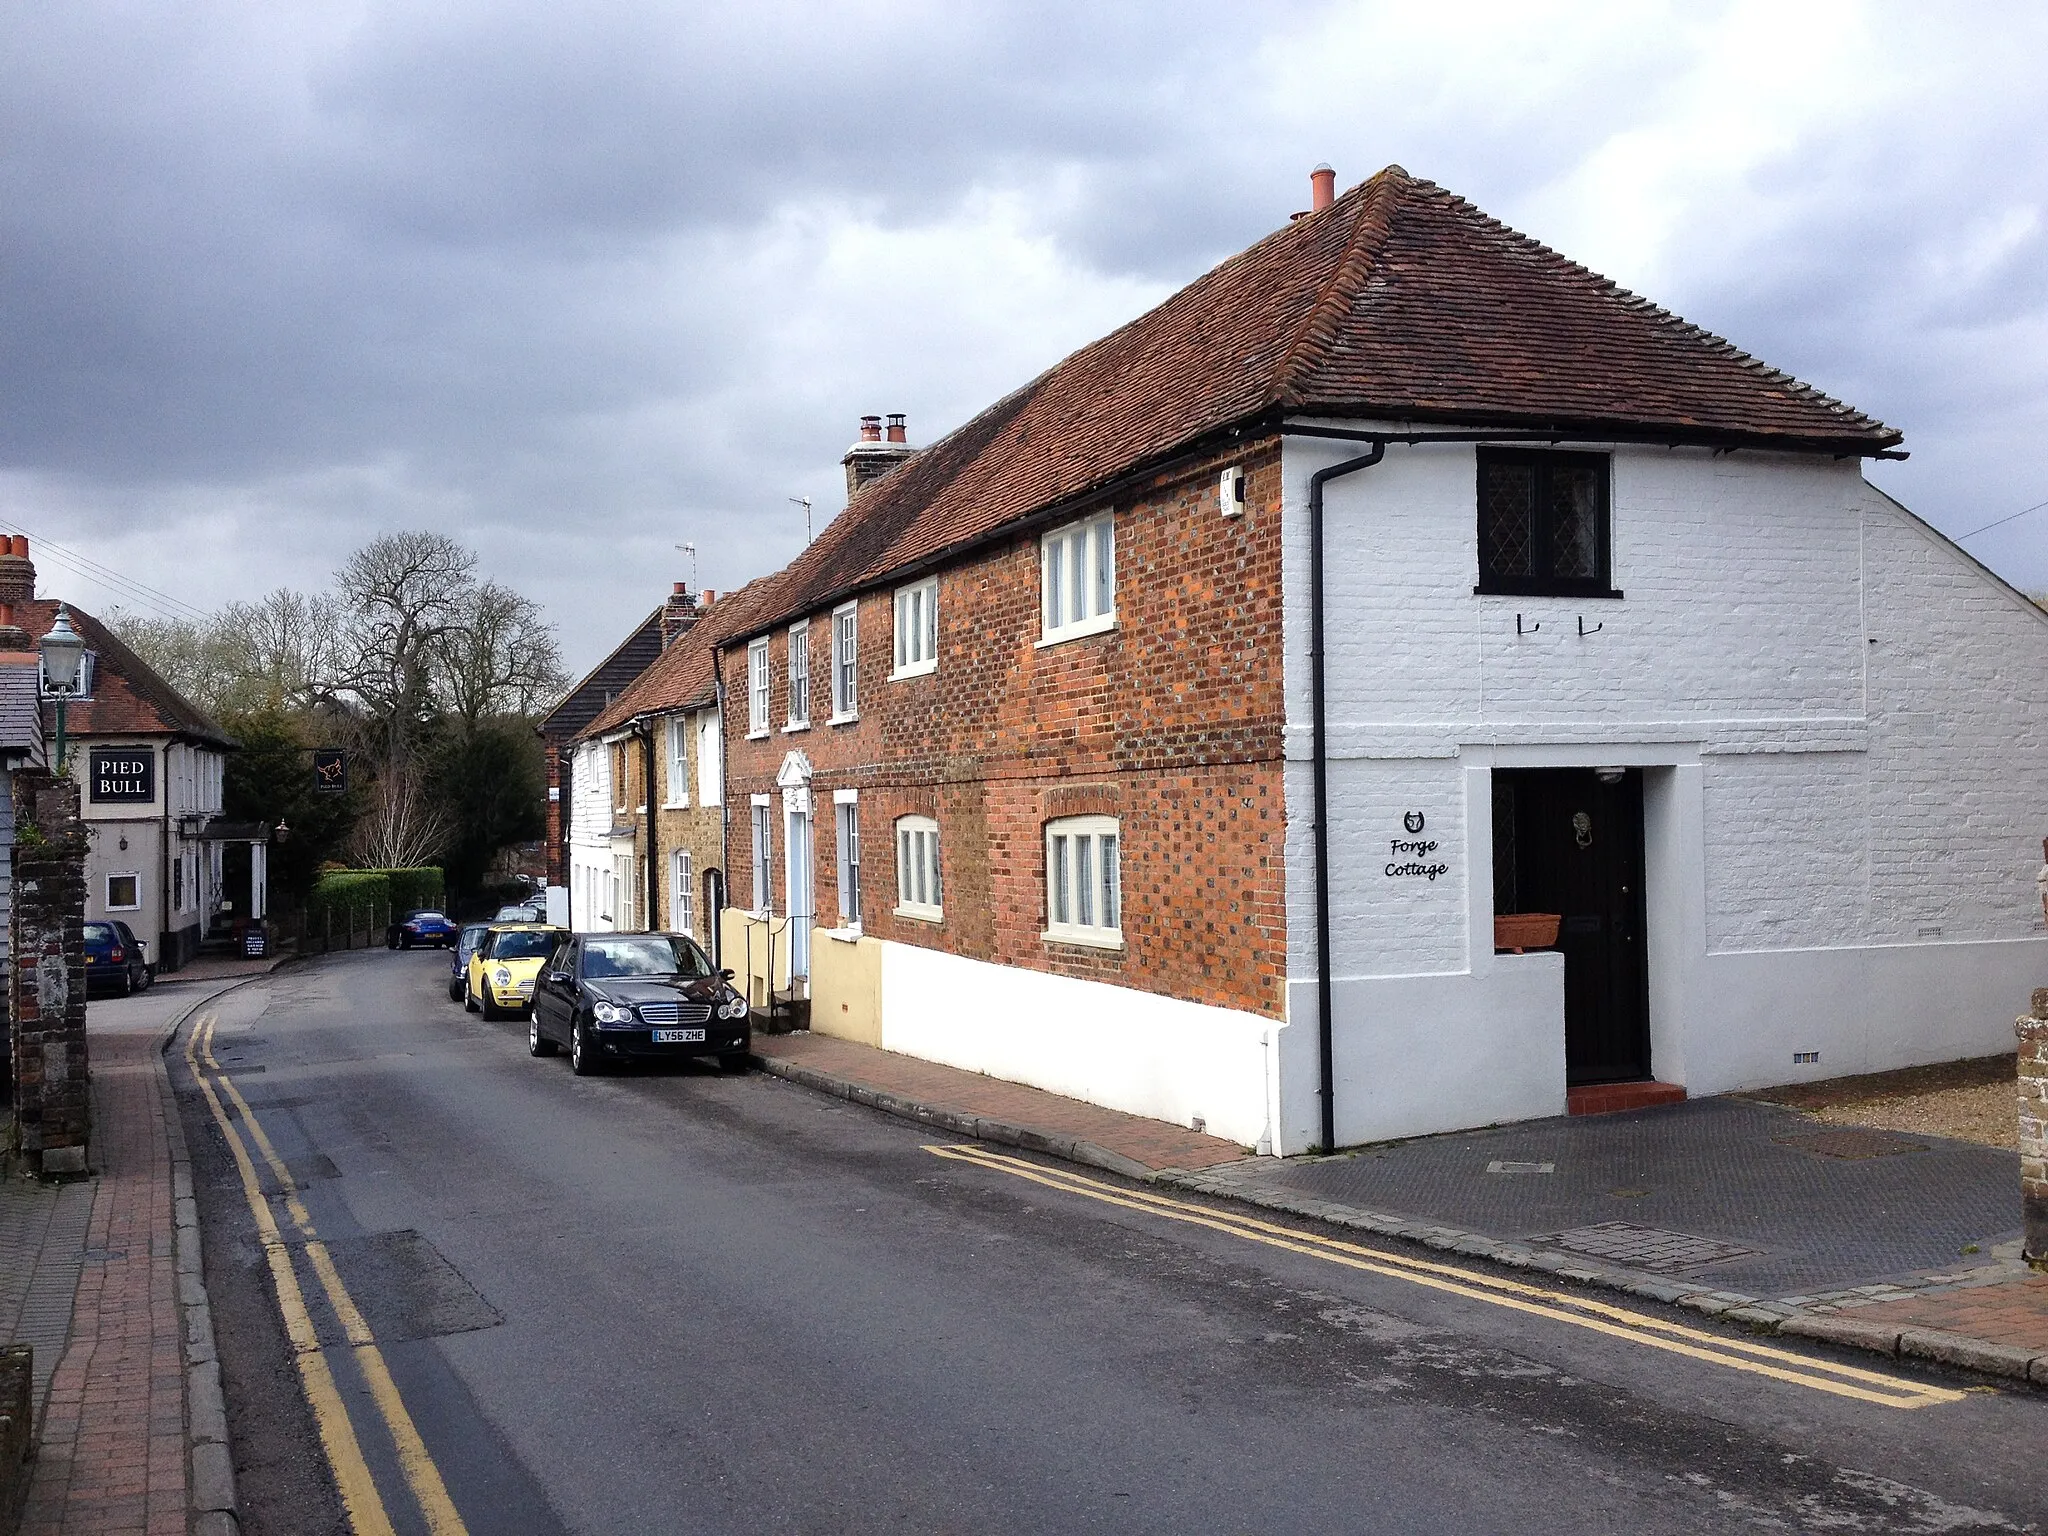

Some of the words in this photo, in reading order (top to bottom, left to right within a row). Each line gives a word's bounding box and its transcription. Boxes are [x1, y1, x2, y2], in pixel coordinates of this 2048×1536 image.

[100, 760, 144, 774] PIED
[100, 779, 146, 793] BULL
[1390, 839, 1438, 857] Forge
[1385, 862, 1449, 881] Cottage
[658, 1031, 684, 1041] LY56
[685, 1030, 704, 1040] ZHE
